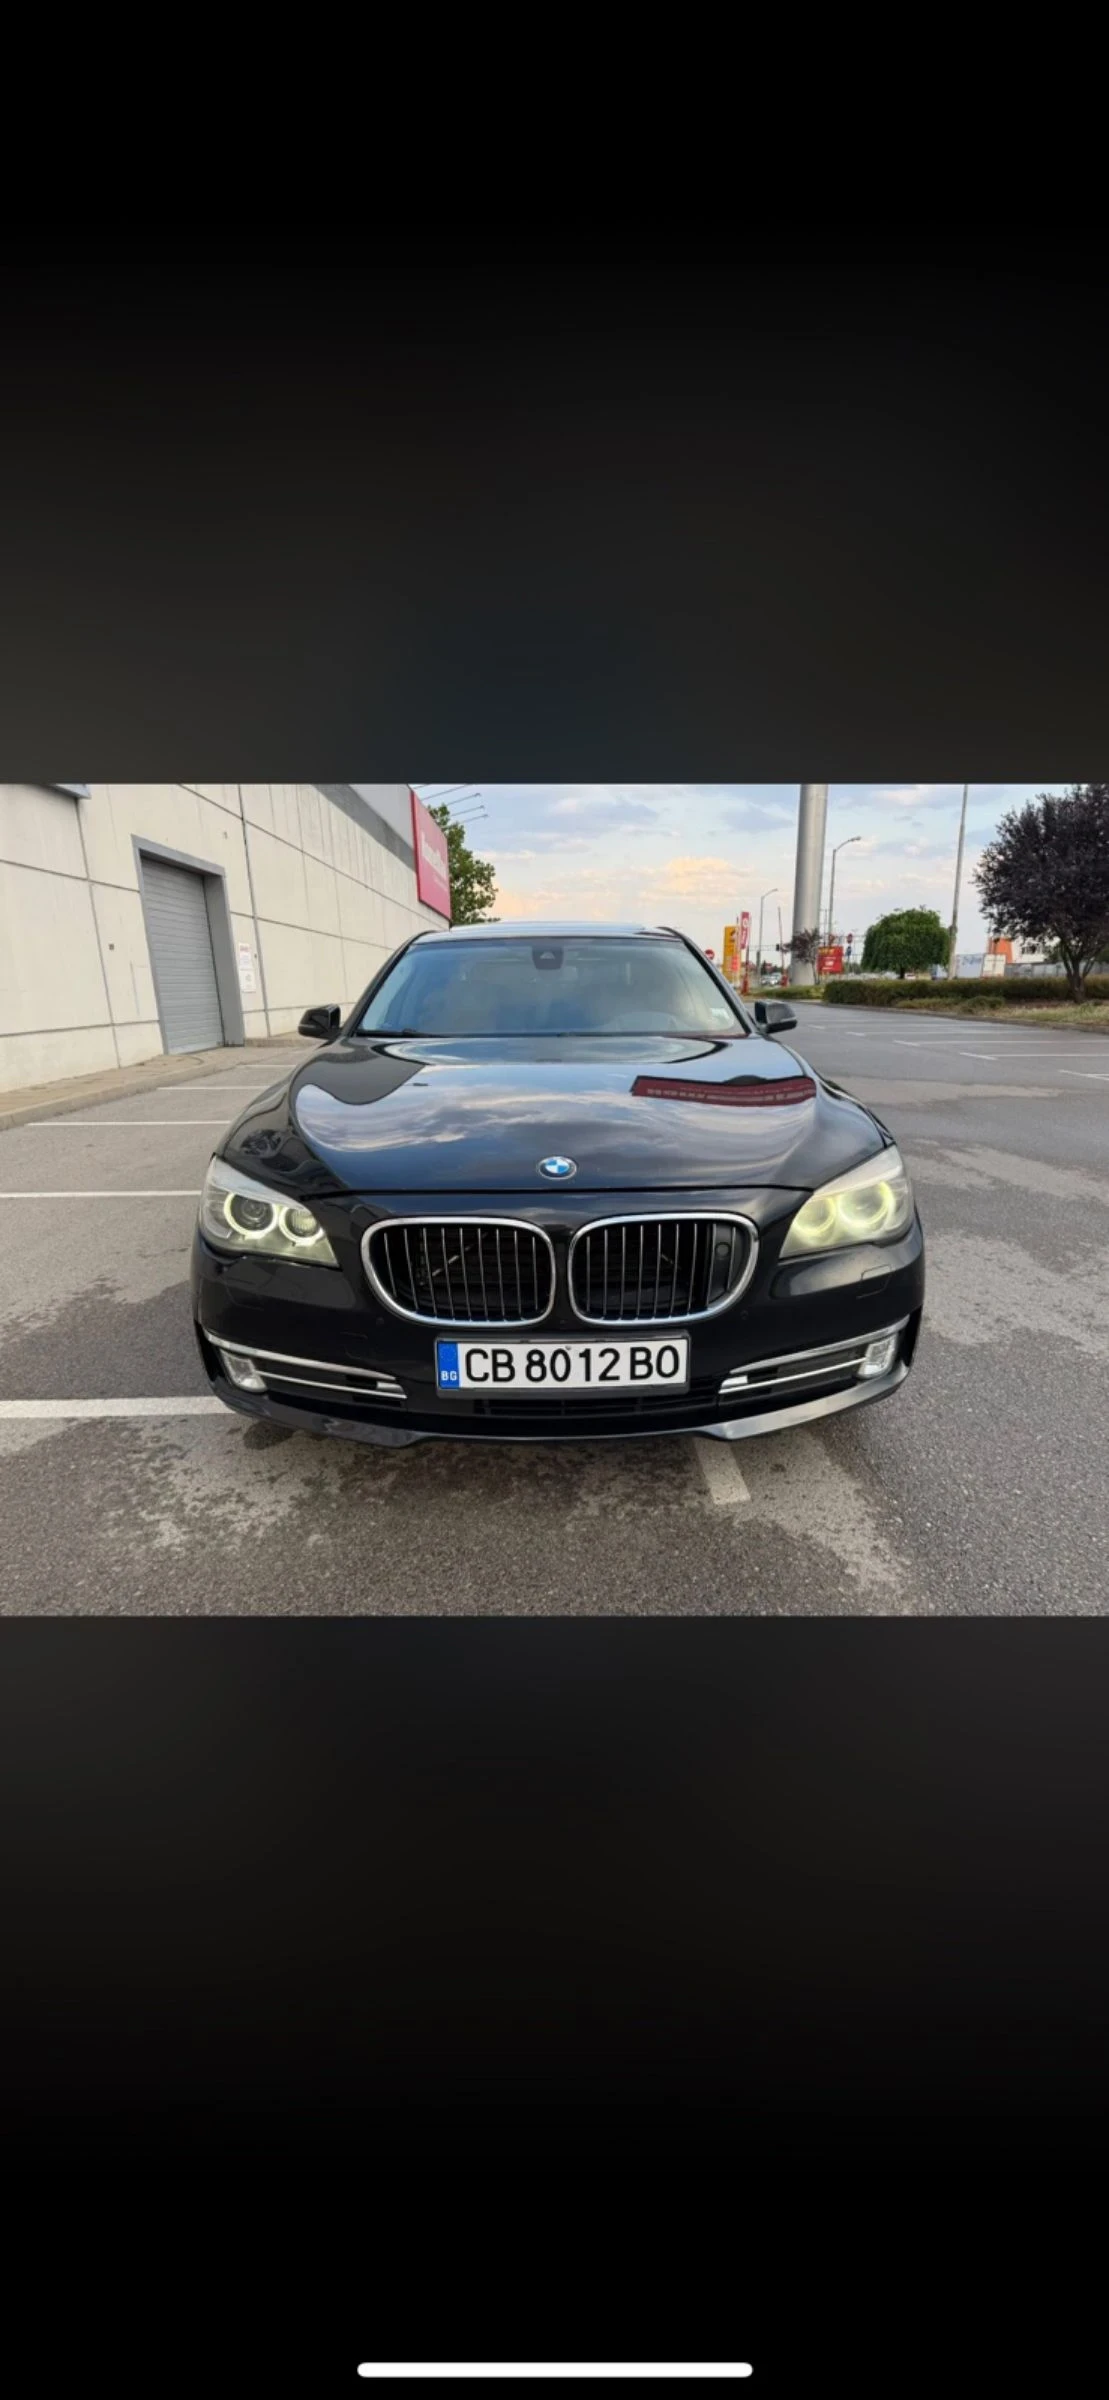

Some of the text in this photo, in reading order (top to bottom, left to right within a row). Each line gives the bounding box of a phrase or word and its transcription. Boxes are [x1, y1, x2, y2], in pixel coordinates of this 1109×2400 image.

[441, 1370, 457, 1381] BG
[465, 1345, 680, 1382] CB 8012 BO
